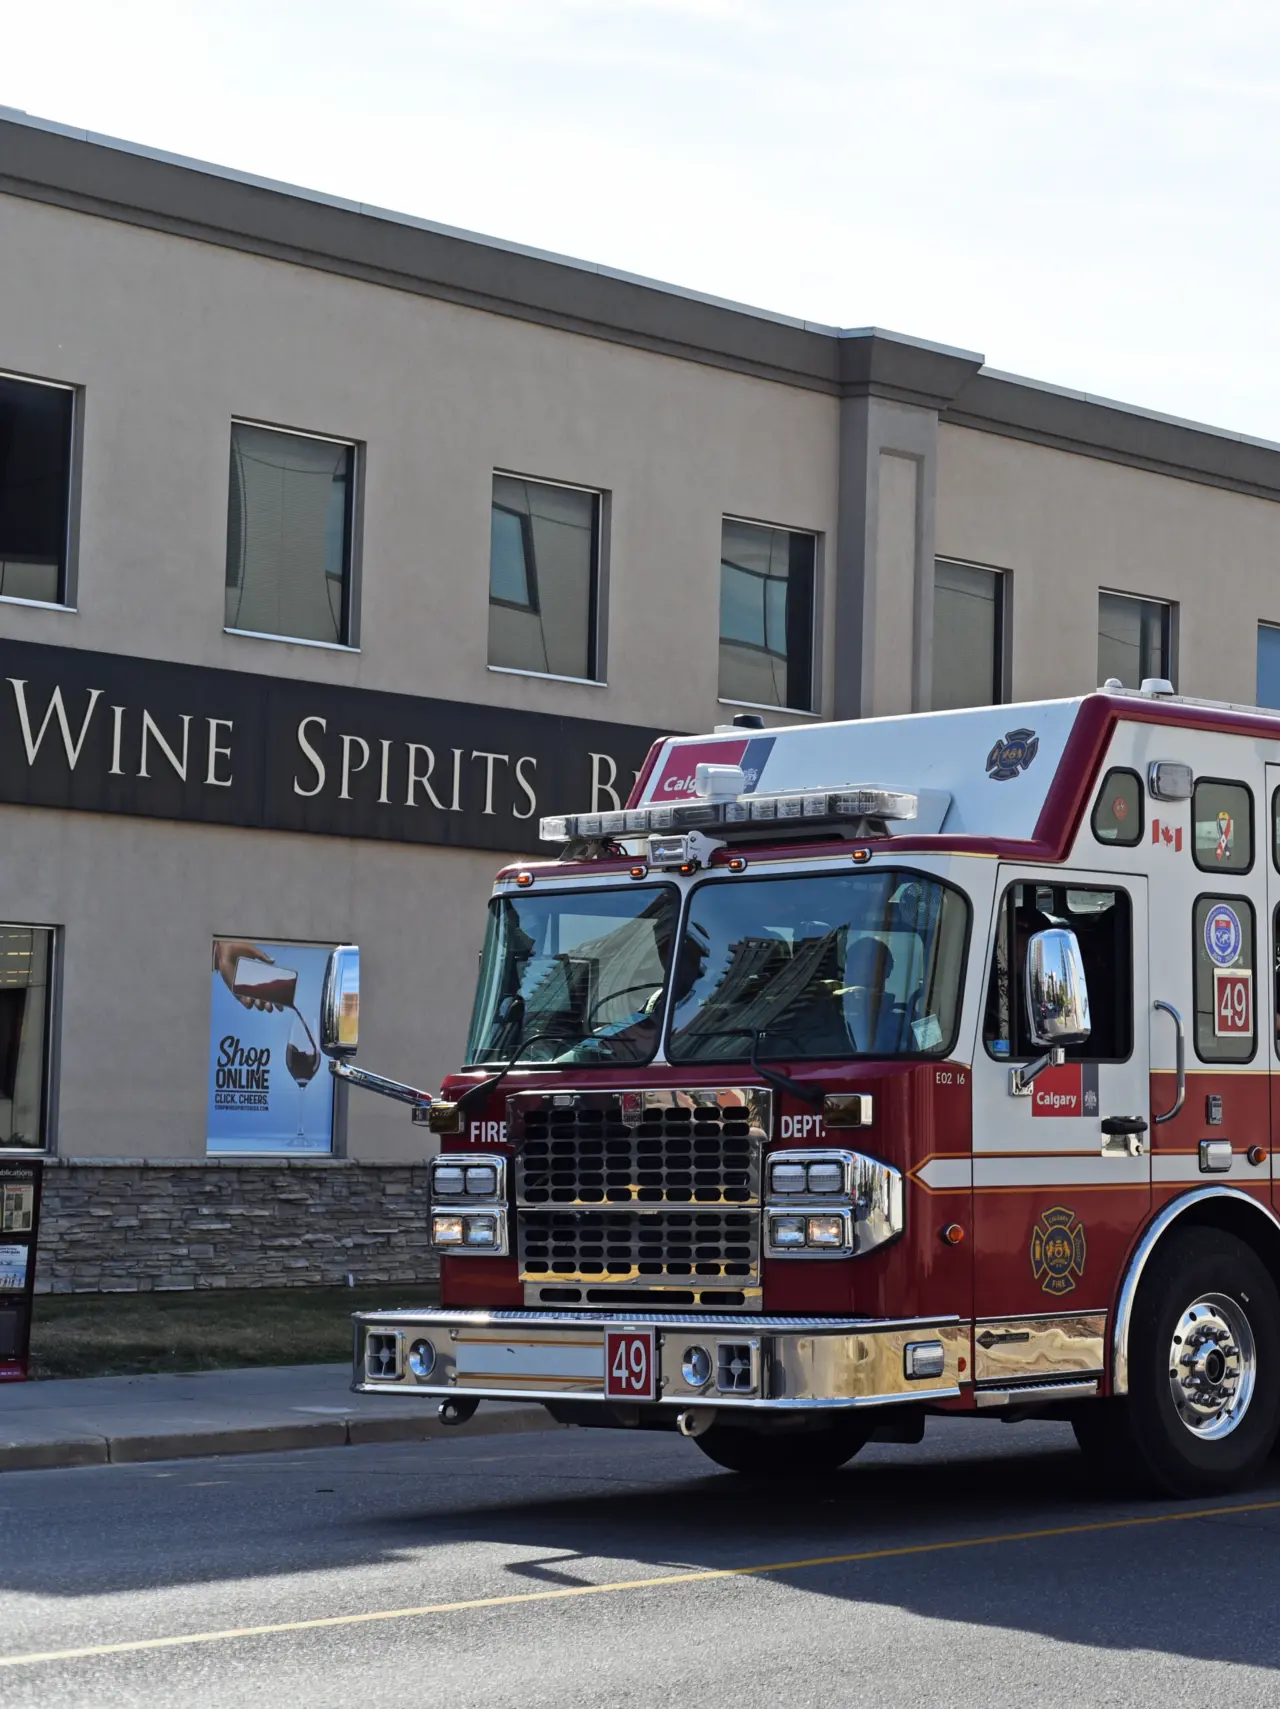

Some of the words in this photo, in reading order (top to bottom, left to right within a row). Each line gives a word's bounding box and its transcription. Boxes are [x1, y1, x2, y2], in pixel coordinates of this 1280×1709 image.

[5, 678, 235, 787] WINE
[293, 716, 538, 819] SPIRITS
[588, 752, 642, 814] B
[664, 776, 697, 794] Calg
[1221, 983, 1247, 1028] 49
[217, 1035, 271, 1076] Shop
[215, 1068, 270, 1090] ONLINE
[936, 1073, 953, 1085] E02
[1036, 1091, 1077, 1108] Calgary
[470, 1121, 508, 1143] FIRE
[781, 1115, 826, 1139] DEPT.
[612, 1339, 647, 1390] 49
